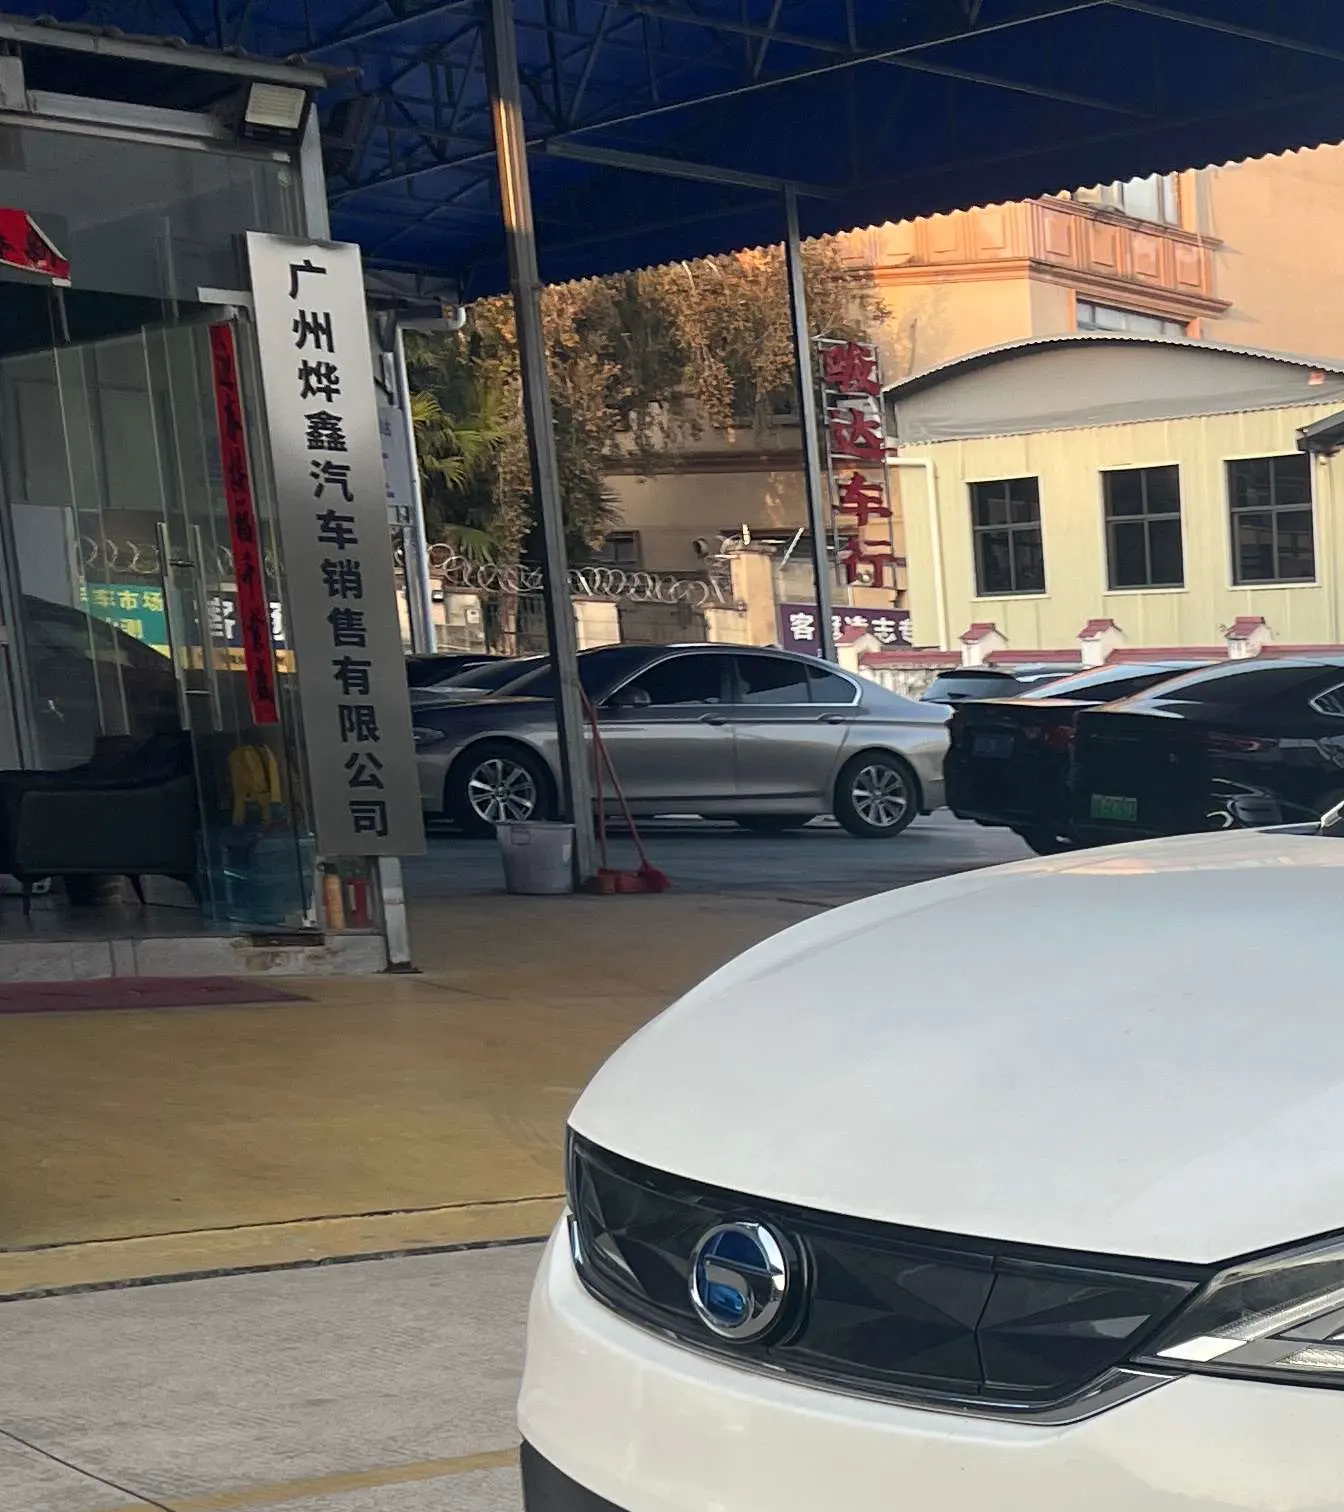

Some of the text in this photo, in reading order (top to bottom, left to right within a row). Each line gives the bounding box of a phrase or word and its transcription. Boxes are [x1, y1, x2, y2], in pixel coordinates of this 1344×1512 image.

[289, 259, 388, 837] 广州烨鑫汽车销售有限公司
